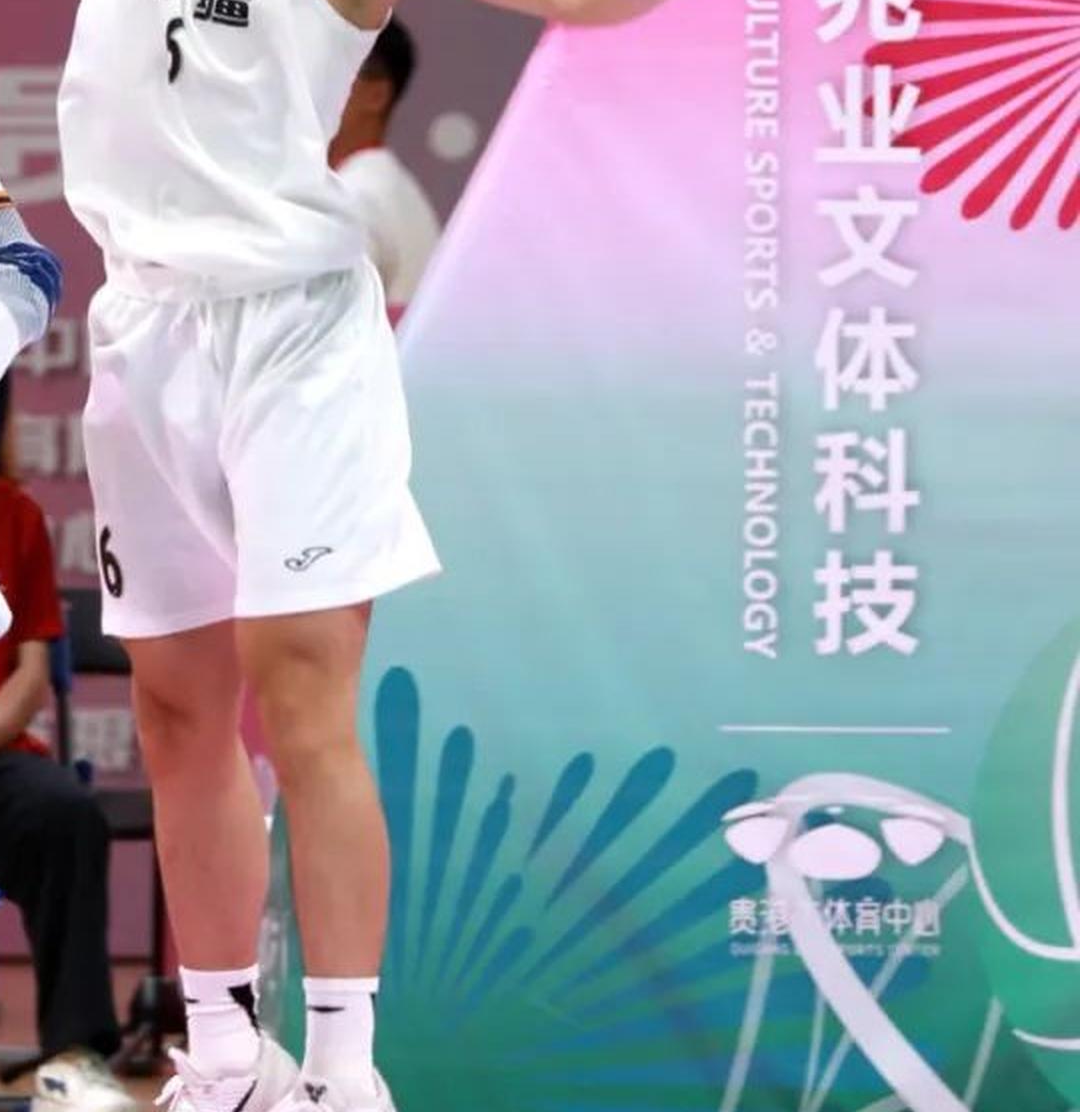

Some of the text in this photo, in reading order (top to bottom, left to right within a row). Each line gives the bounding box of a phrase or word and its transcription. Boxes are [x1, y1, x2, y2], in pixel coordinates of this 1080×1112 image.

[743, 151, 780, 311] SPORTS
[744, 327, 778, 357] &
[743, 371, 779, 660] TECHNOLOGY
